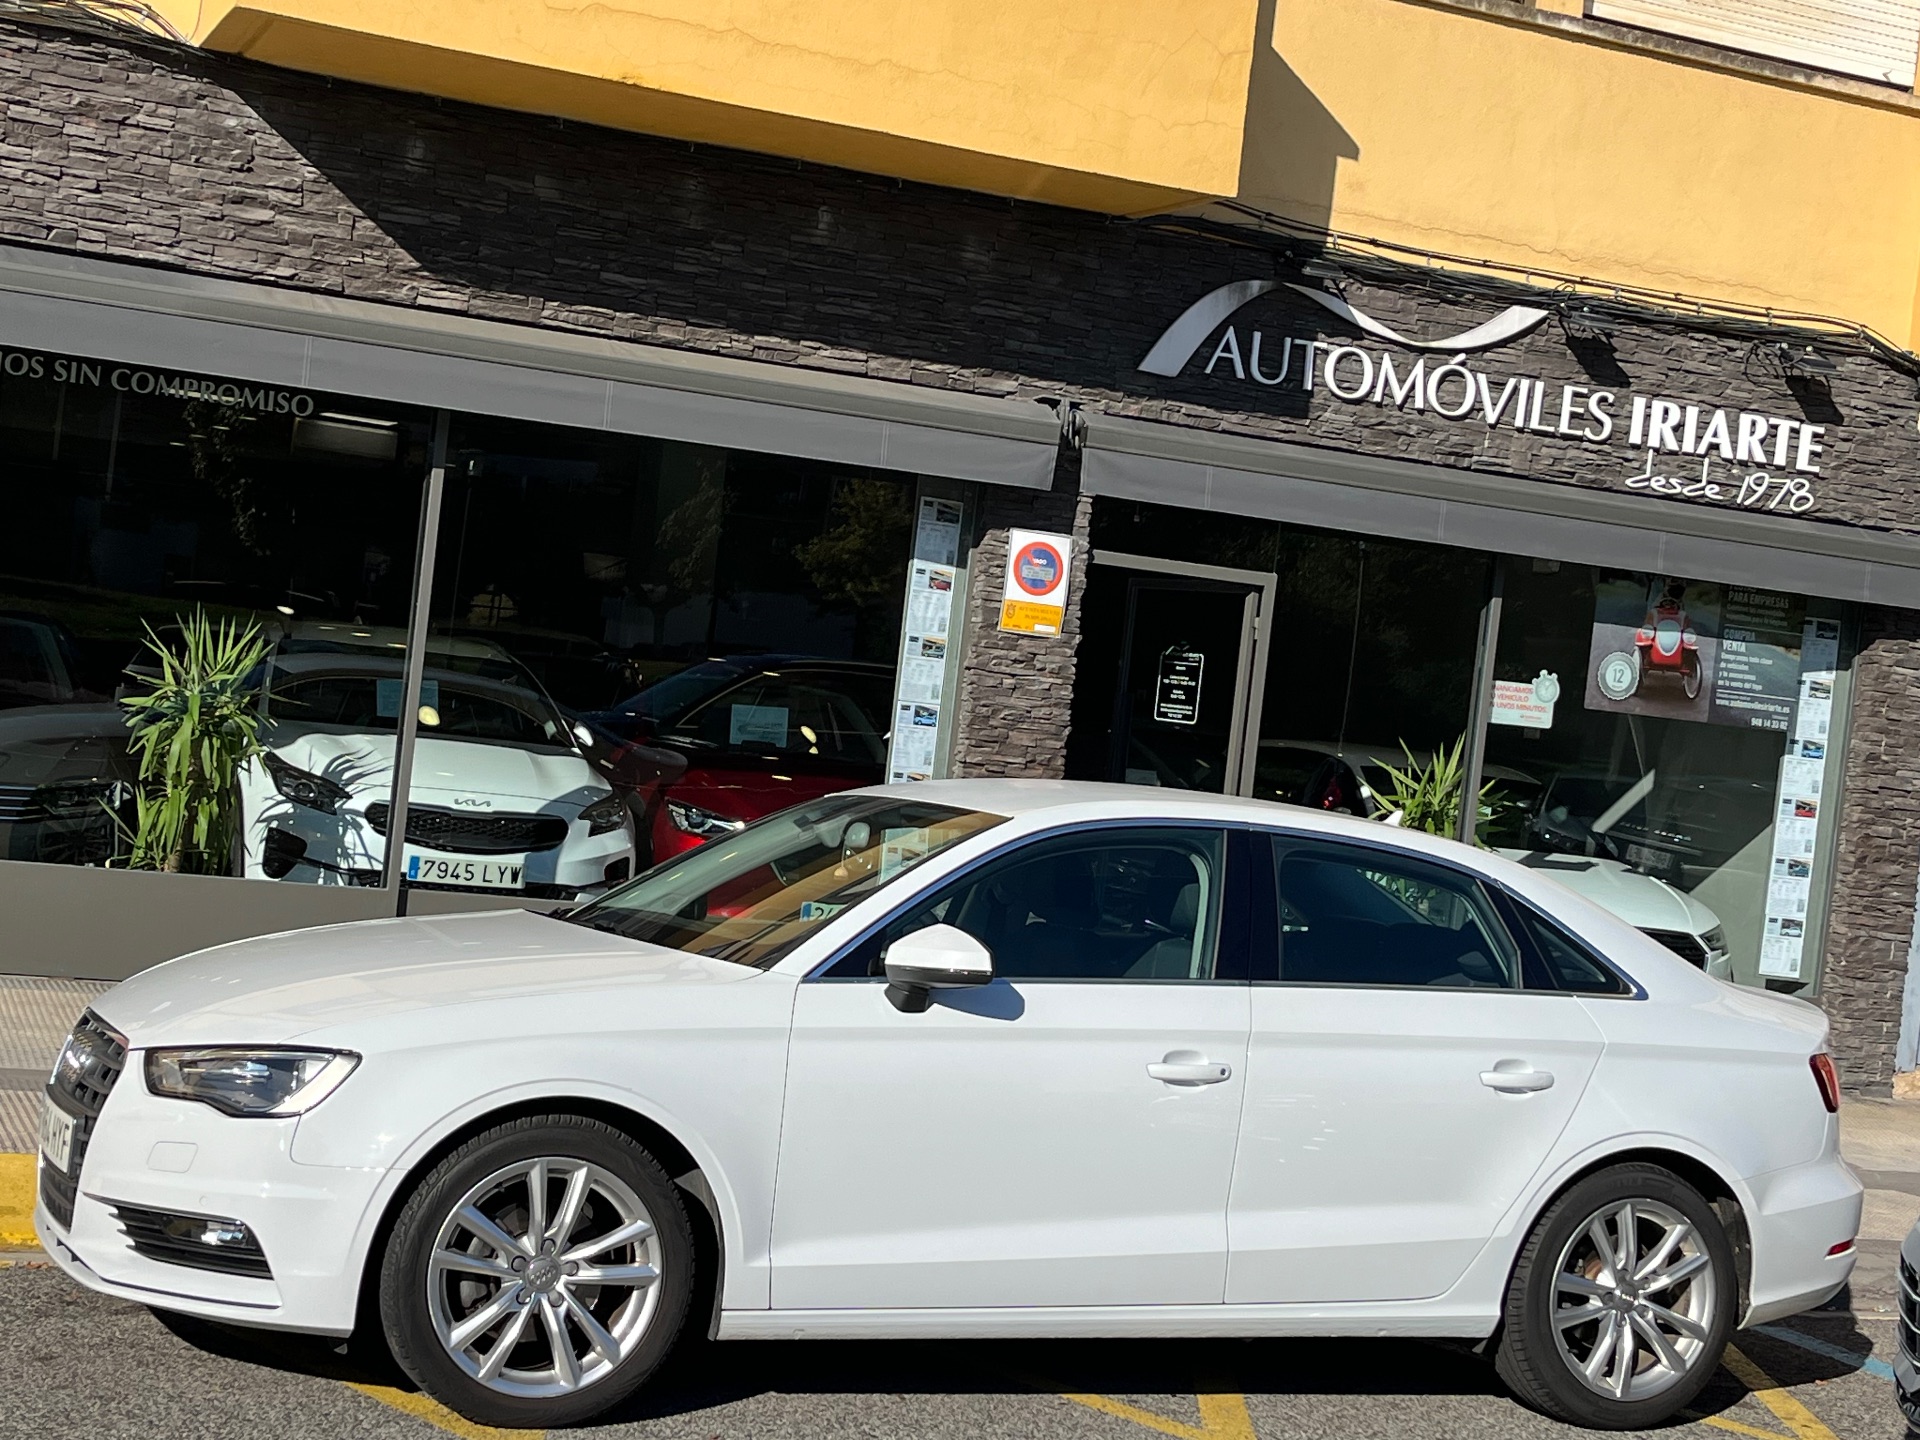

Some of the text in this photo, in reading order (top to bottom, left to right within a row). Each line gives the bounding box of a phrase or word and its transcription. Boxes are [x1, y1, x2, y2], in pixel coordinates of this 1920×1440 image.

[0, 351, 315, 417] OS SIN COMPROMISO
[1204, 325, 1826, 474] AUTOMÓVILES IRIARTE
[1625, 449, 1815, 513] desde 1978
[1750, 594, 1790, 609] EMPRESAS
[1723, 628, 1756, 642] COMPRA
[1722, 640, 1747, 653] VENTA
[1612, 668, 1624, 684] 12
[421, 859, 523, 885] 7945 LYW
